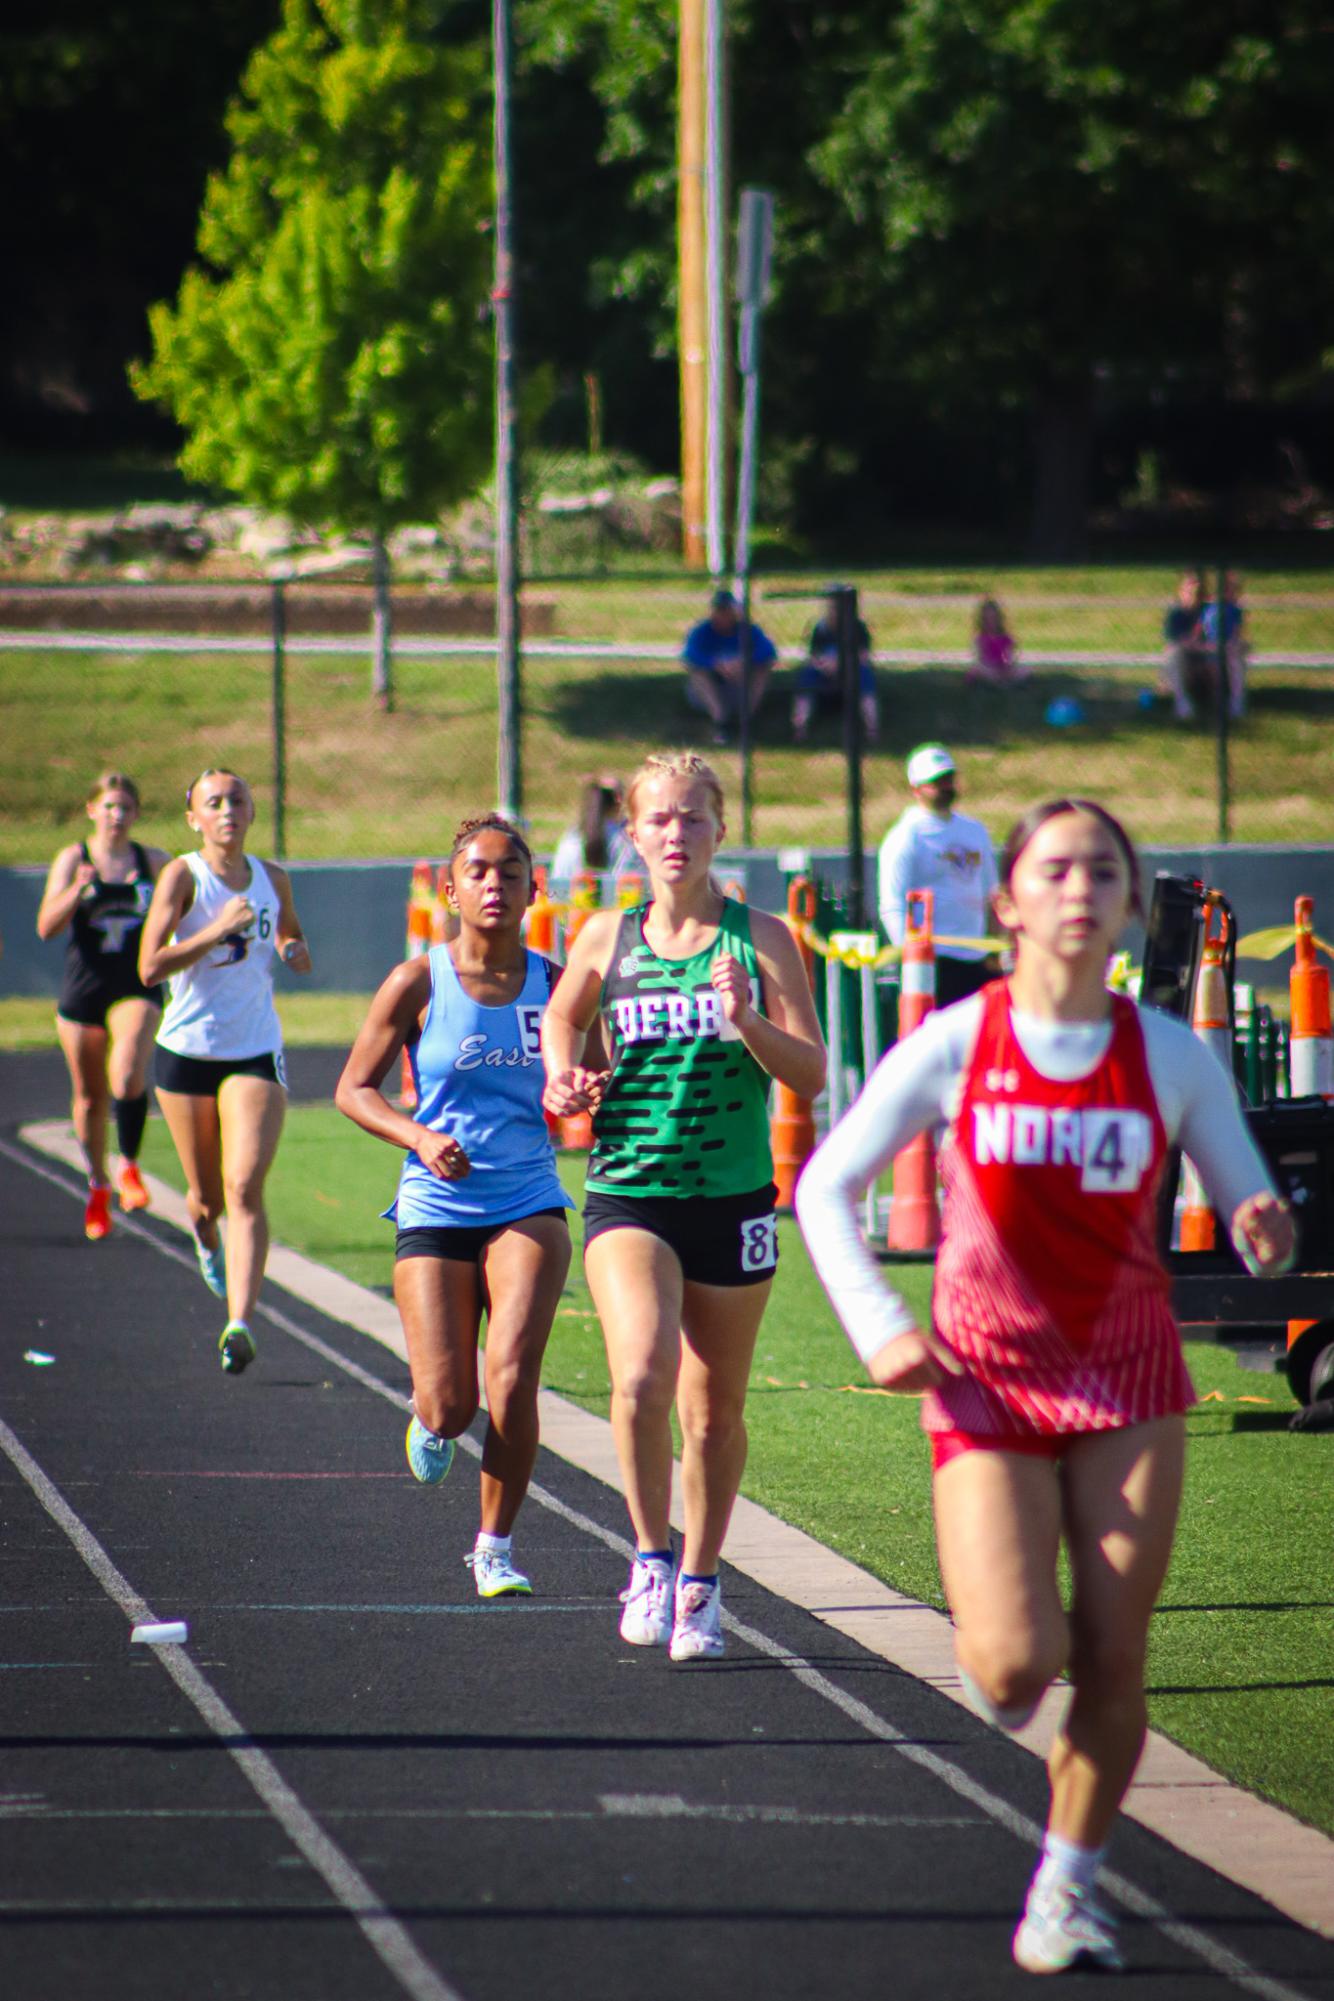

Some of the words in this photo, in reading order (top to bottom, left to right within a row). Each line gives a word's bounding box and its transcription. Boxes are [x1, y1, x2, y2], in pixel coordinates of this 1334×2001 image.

[258, 908, 271, 939] 6
[523, 1011, 542, 1053] 5
[616, 992, 721, 1043] DERB
[1090, 1122, 1124, 1182] 4
[748, 1223, 768, 1265] 8
